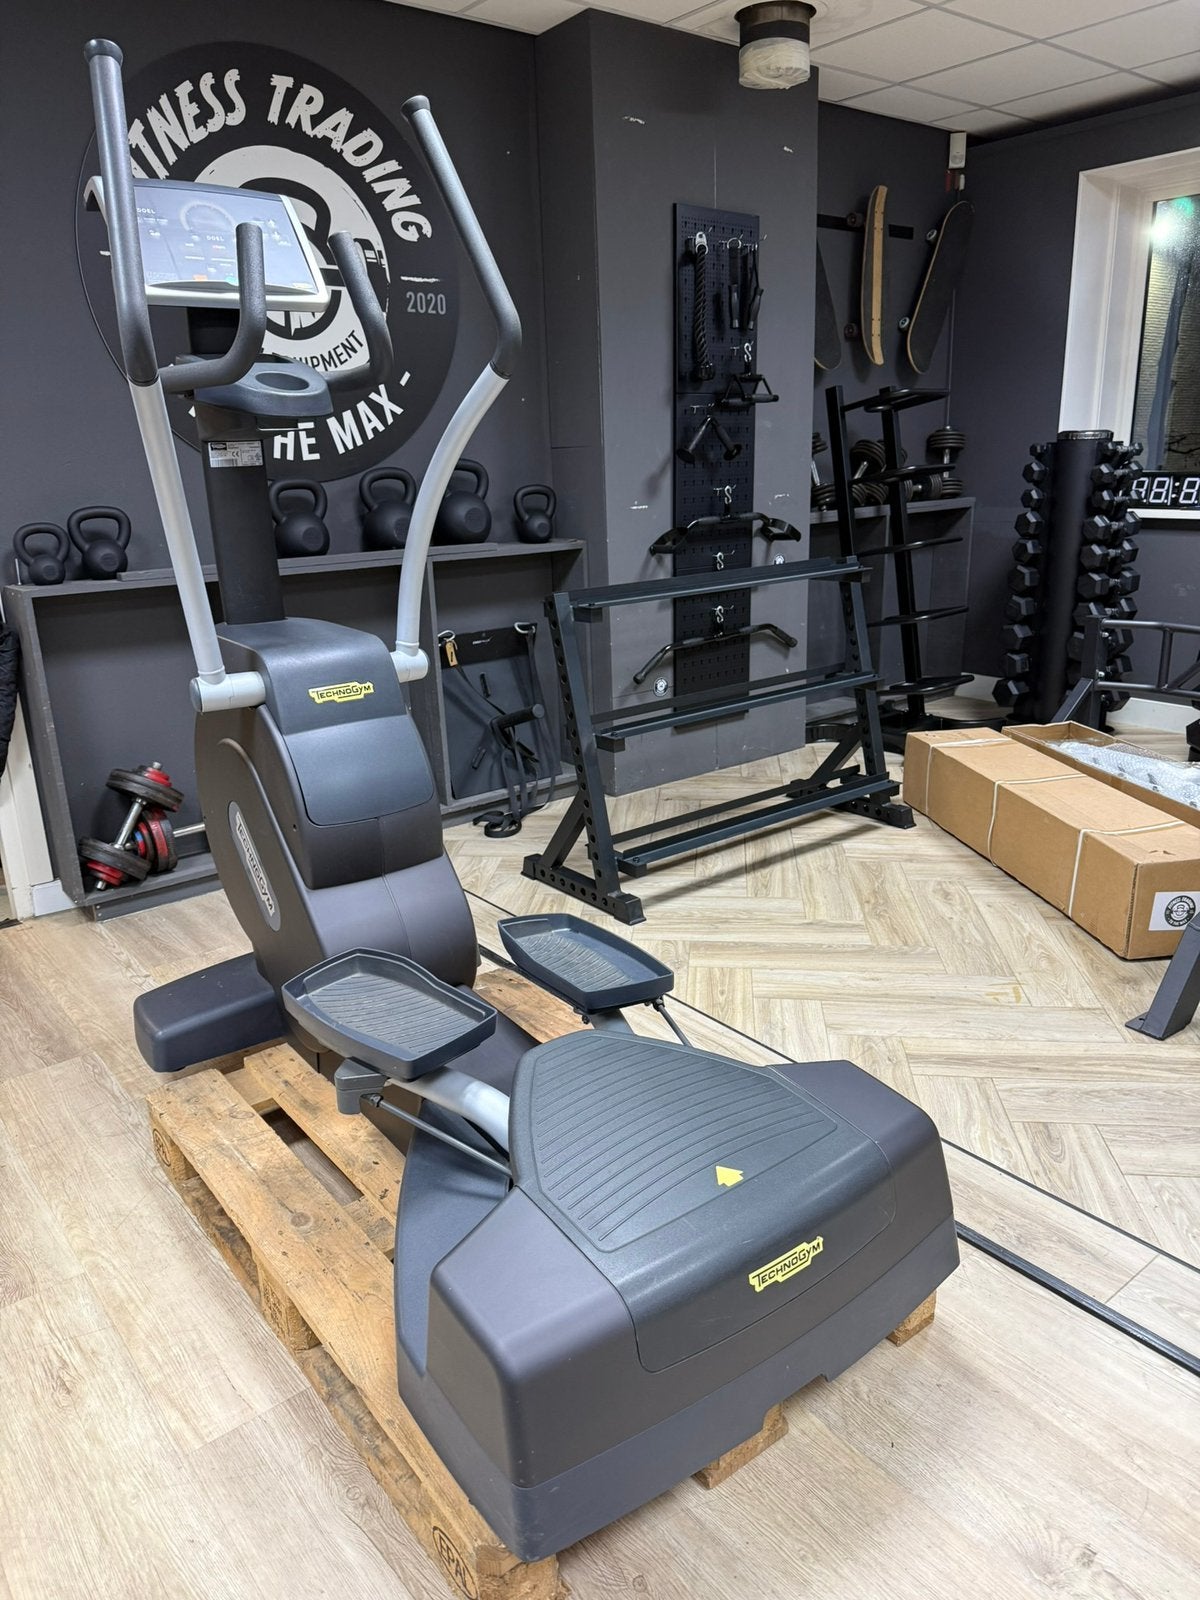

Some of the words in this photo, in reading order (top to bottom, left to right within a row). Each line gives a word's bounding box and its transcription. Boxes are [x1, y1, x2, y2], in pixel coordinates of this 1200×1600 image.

[128, 69, 246, 180] TNESS
[267, 74, 432, 242] TRADING
[406, 291, 446, 314] 2020
[273, 421, 321, 461] HE
[326, 384, 404, 455] MAX
[311, 684, 372, 700] TECHNOGYM
[751, 1241, 821, 1288] TECHNOGYM
